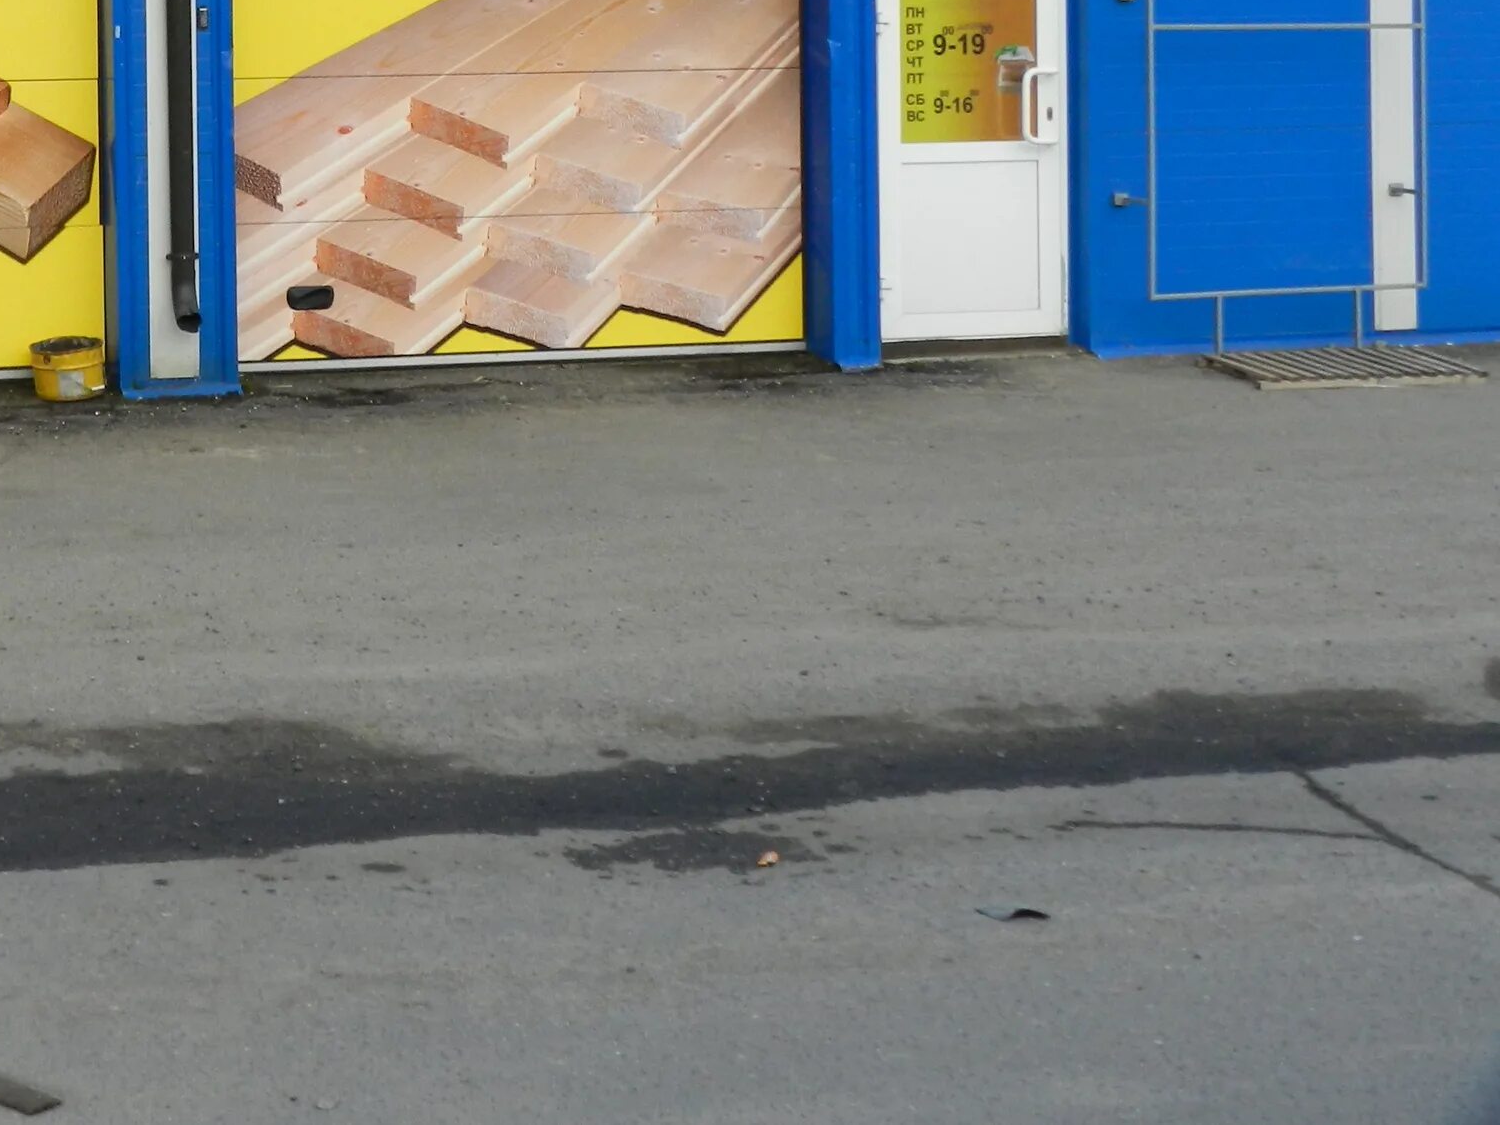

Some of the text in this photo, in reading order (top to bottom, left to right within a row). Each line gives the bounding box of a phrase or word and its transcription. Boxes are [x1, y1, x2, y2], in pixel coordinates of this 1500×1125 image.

[906, 7, 925, 18] ПН
[906, 24, 922, 35] ВТ
[906, 40, 924, 51] СР
[906, 57, 923, 67] ЧТ
[906, 73, 924, 84] ПТ
[906, 94, 925, 105] СБ
[907, 111, 925, 122] ВС
